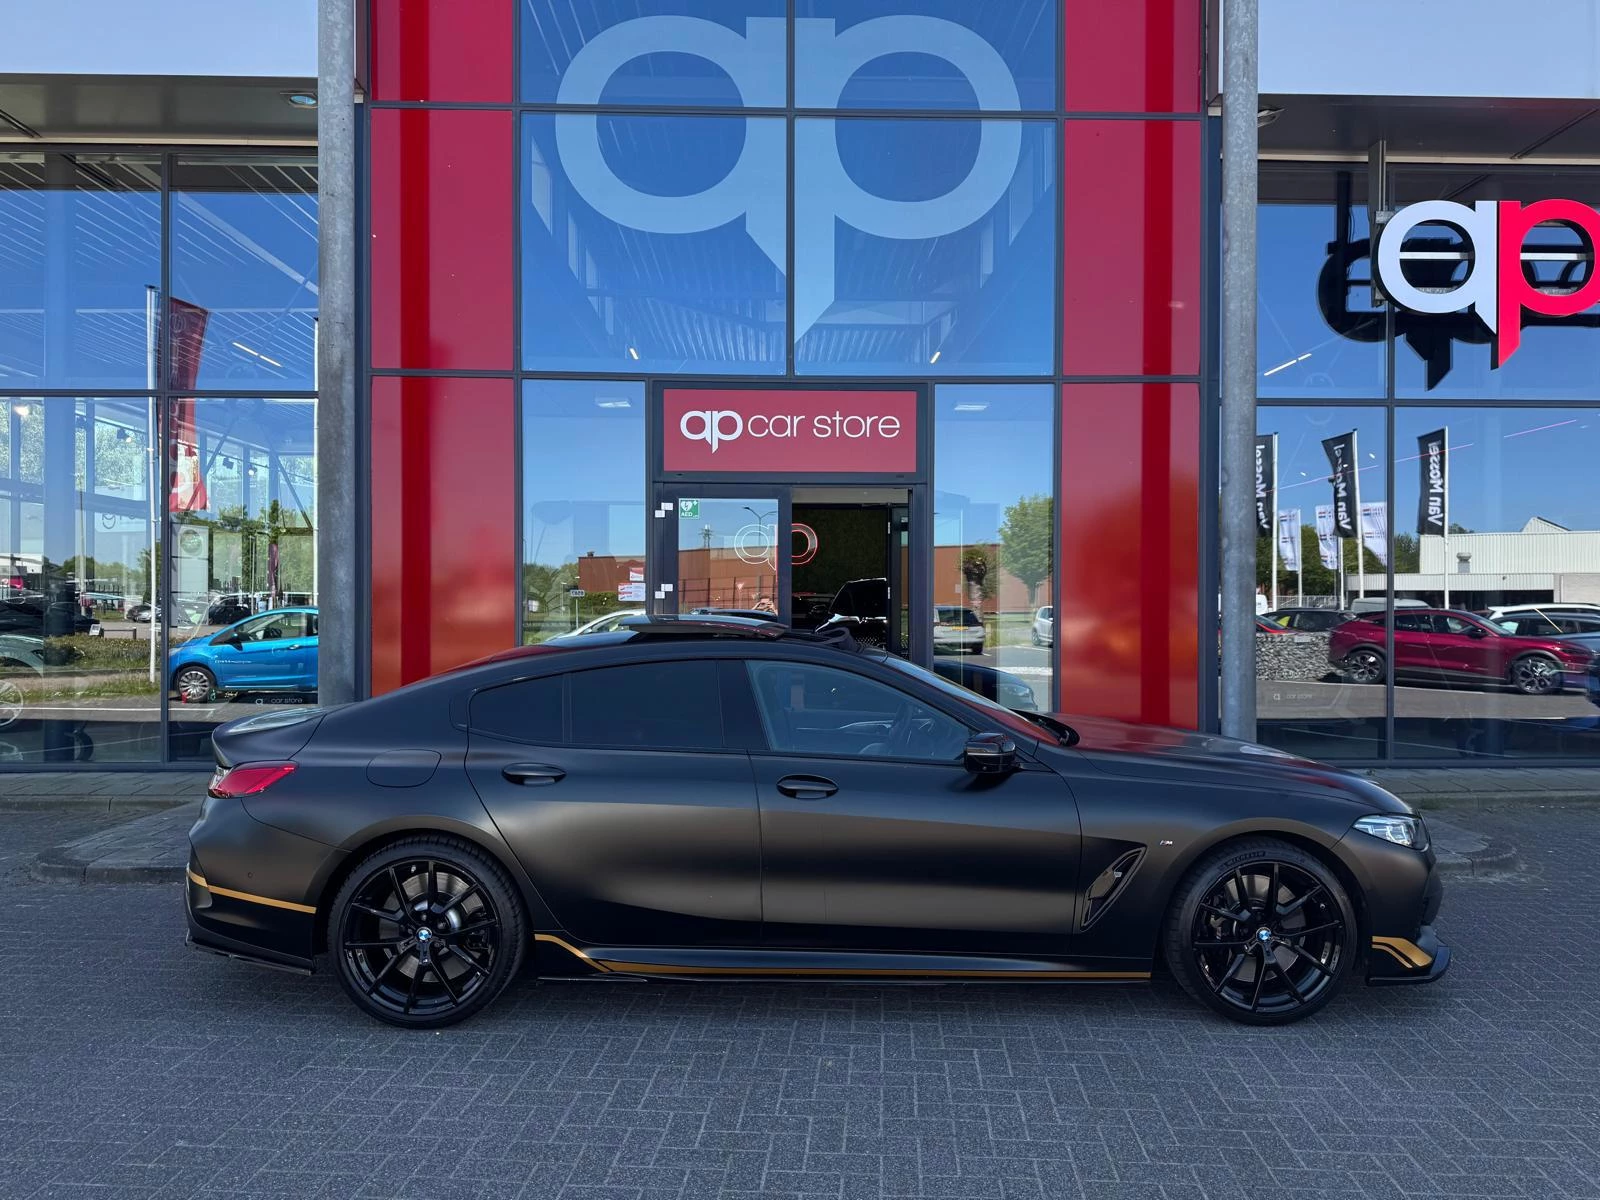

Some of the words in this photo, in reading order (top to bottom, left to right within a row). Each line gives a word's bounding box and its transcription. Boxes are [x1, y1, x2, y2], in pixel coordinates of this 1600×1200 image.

[555, 15, 1022, 344] ap
[1378, 199, 1600, 368] ap
[680, 410, 743, 453] ap
[748, 414, 805, 438] car
[812, 410, 900, 438] store
